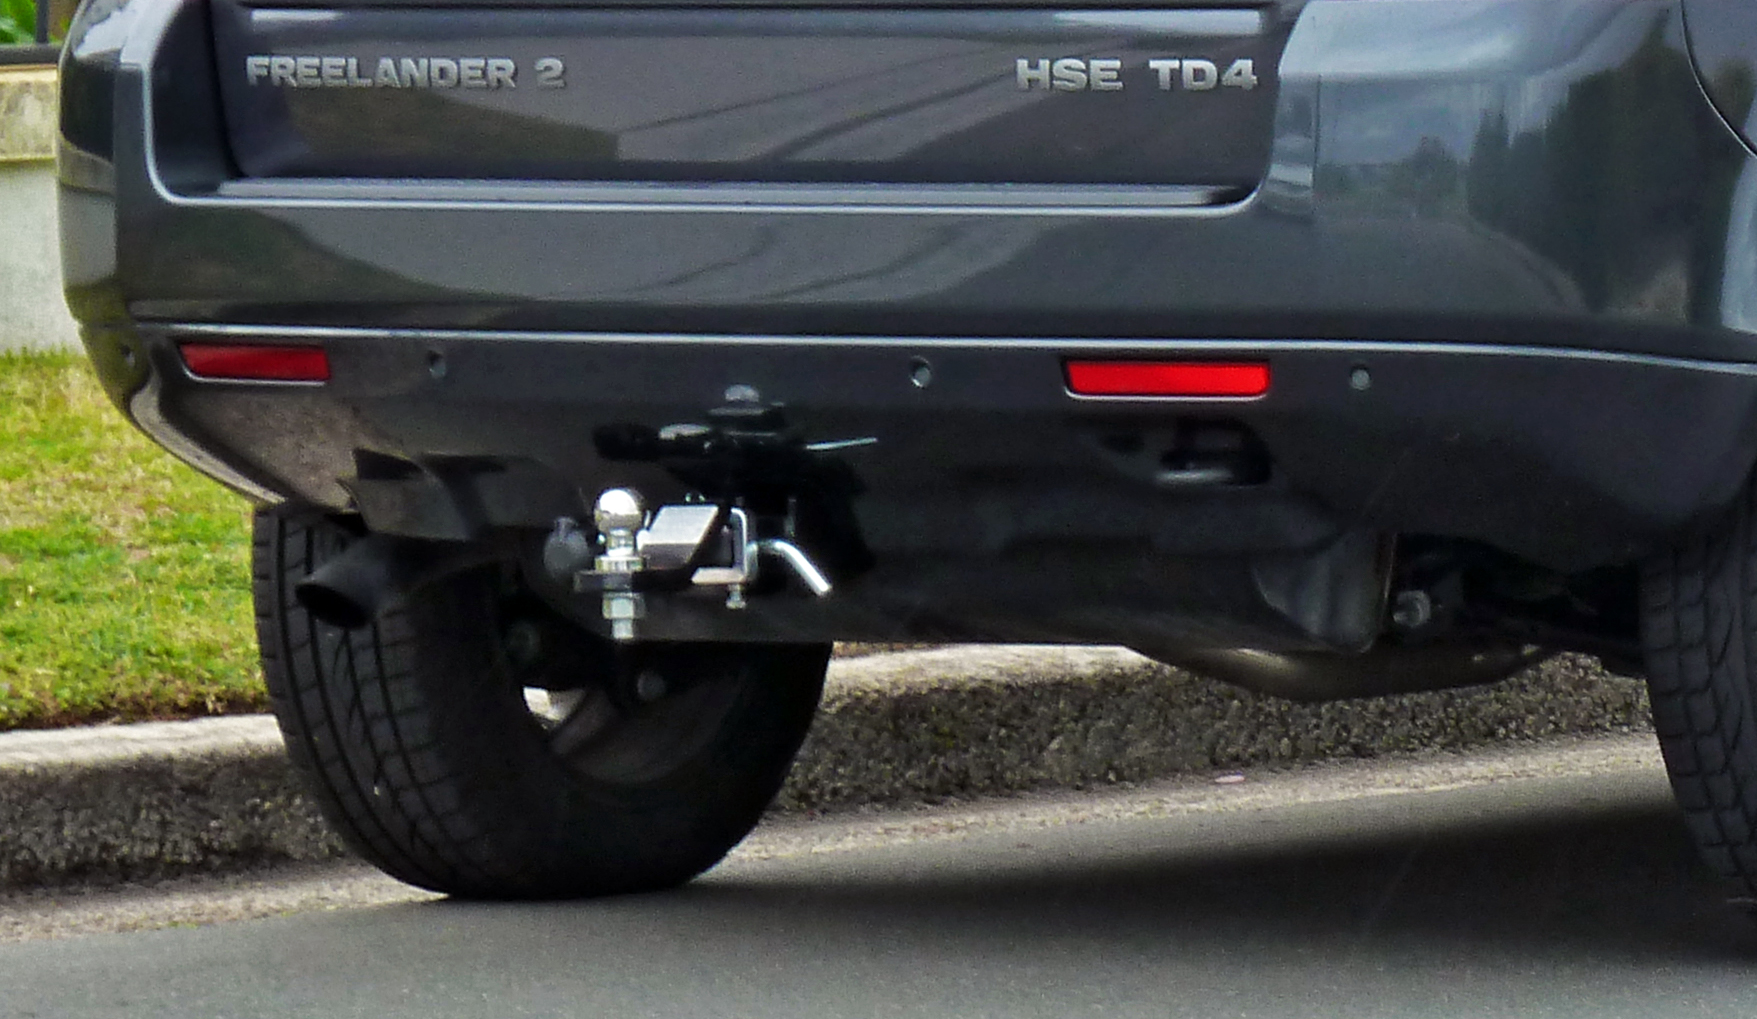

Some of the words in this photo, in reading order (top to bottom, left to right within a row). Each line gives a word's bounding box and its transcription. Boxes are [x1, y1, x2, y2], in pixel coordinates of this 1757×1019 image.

[246, 55, 516, 89] FREELANDER
[534, 57, 567, 89] 2
[1016, 58, 1124, 91] HSE
[1149, 58, 1258, 91] TD4
